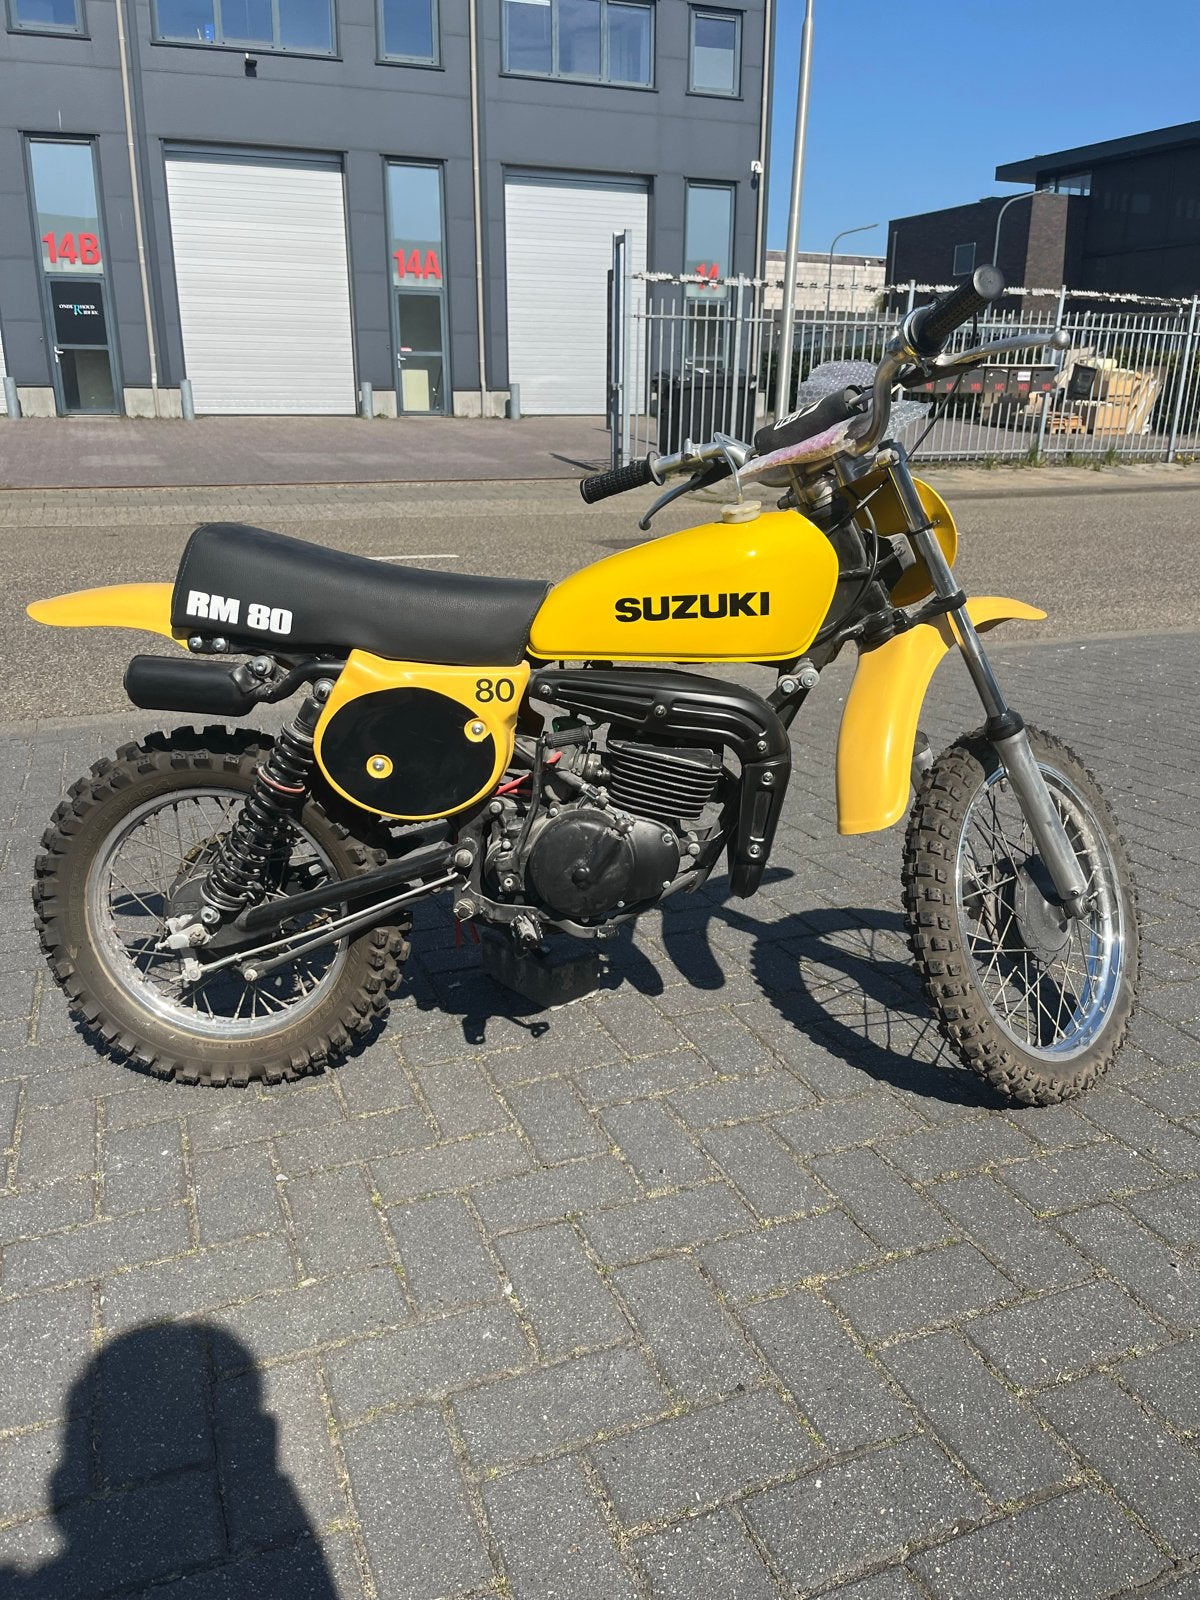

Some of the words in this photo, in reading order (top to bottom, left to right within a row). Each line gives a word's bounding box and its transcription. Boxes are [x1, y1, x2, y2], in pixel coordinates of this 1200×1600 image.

[42, 232, 101, 265] 14B
[393, 248, 442, 279] 14A
[186, 590, 240, 624] RM
[247, 603, 293, 634] 80
[615, 591, 770, 623] SUZUKI
[475, 678, 515, 703] 80
